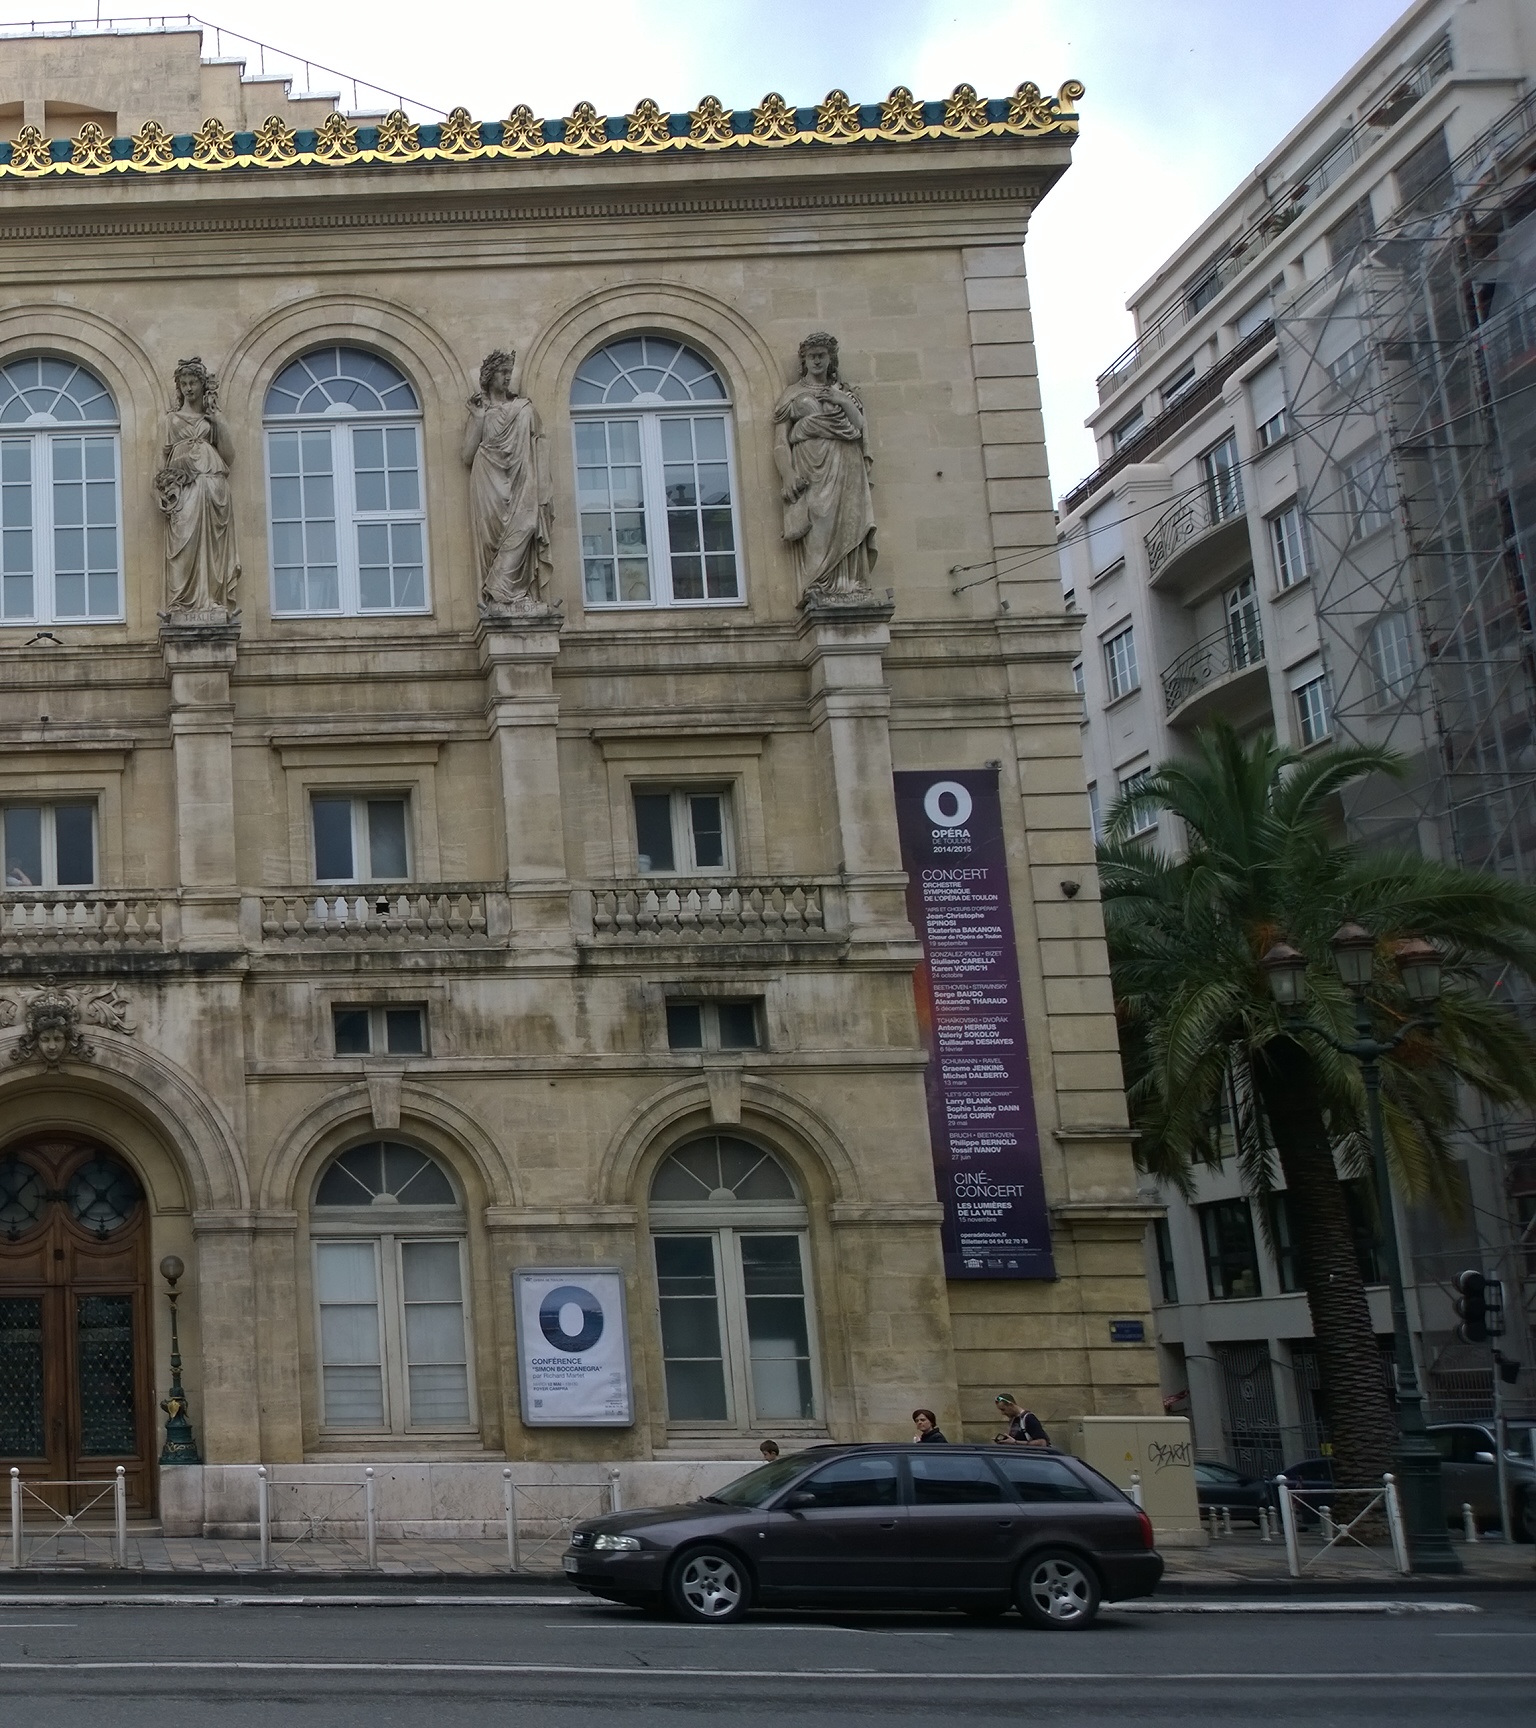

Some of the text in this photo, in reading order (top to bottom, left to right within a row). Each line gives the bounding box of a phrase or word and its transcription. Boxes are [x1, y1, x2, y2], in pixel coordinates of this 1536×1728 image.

[924, 781, 972, 827] O
[932, 828, 970, 838] OPÉRA
[922, 869, 988, 880] CONCERT
[954, 1170, 992, 1184] CINÉ-
[955, 1185, 1024, 1197] CONCERT
[539, 1286, 604, 1353] O
[532, 1357, 582, 1365] CONFÉRENCE
